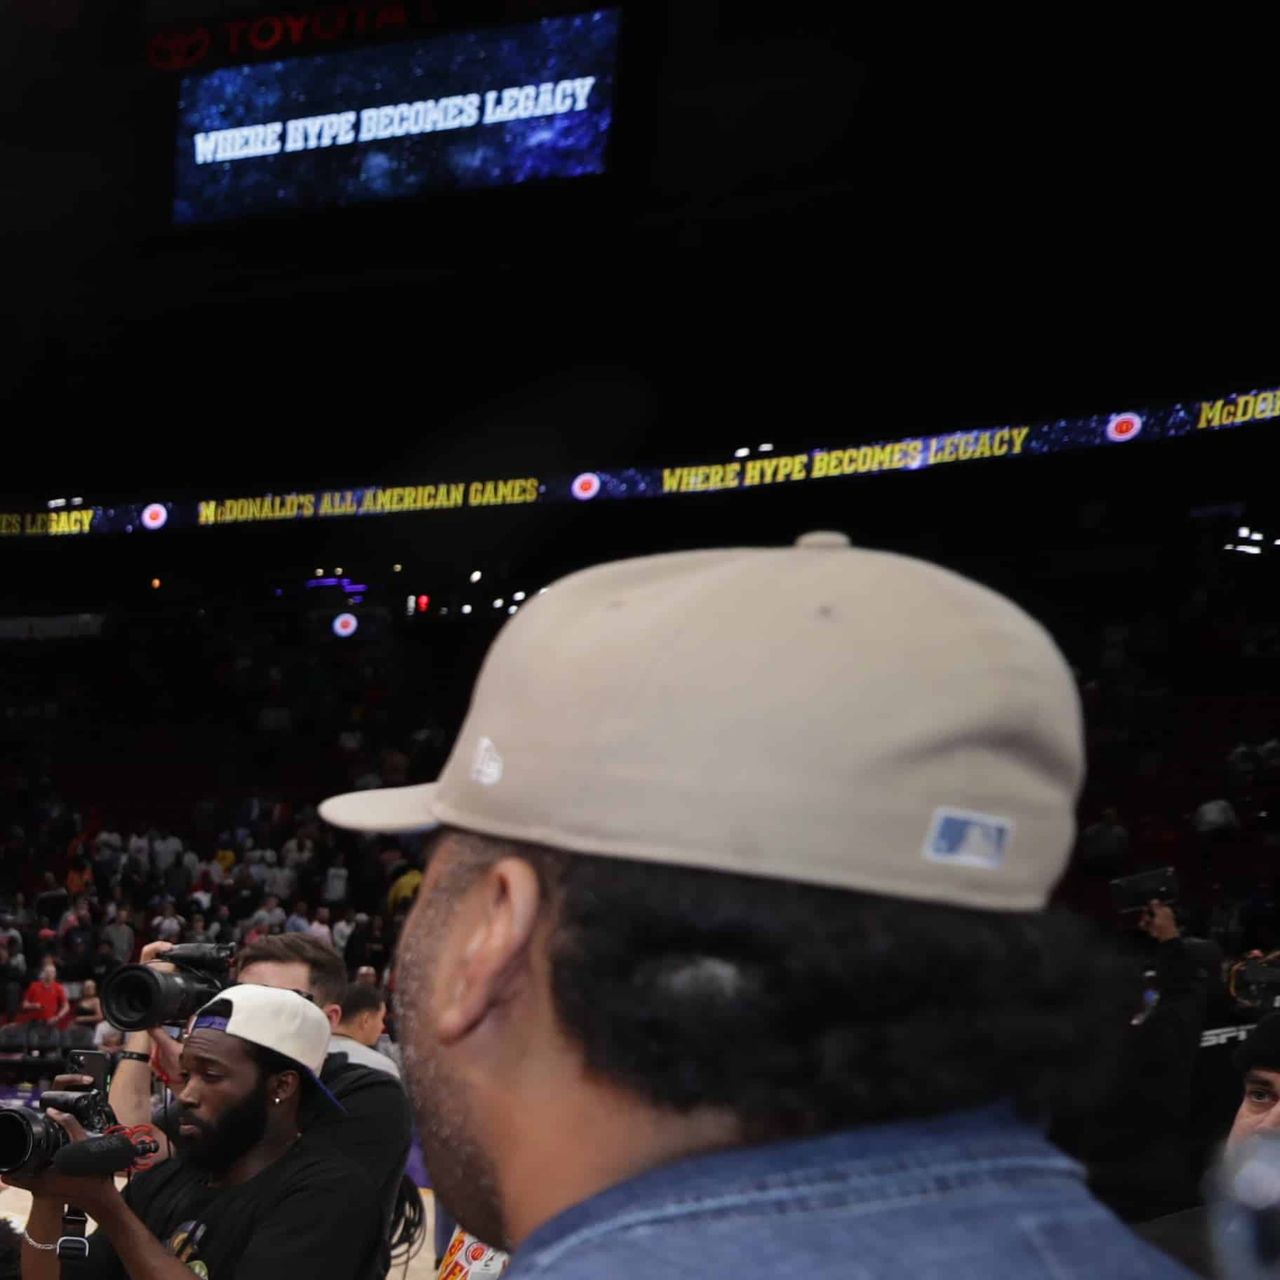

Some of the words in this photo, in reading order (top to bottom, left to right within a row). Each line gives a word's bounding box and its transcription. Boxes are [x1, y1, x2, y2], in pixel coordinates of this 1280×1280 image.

[193, 121, 283, 165] WHERE
[285, 110, 356, 152] HYPE
[358, 92, 480, 142] BECOMES
[483, 75, 596, 124] LEGACY
[661, 462, 739, 494] WHERE
[742, 454, 806, 486] HYPE
[810, 441, 922, 479] BECOMES
[927, 425, 1029, 464] LEGACY
[24, 508, 94, 536] LEGACY
[198, 493, 315, 525] McDONALD'S
[317, 490, 357, 518] ALL
[358, 482, 465, 517] AMERICAN
[467, 477, 539, 507] GAMES
